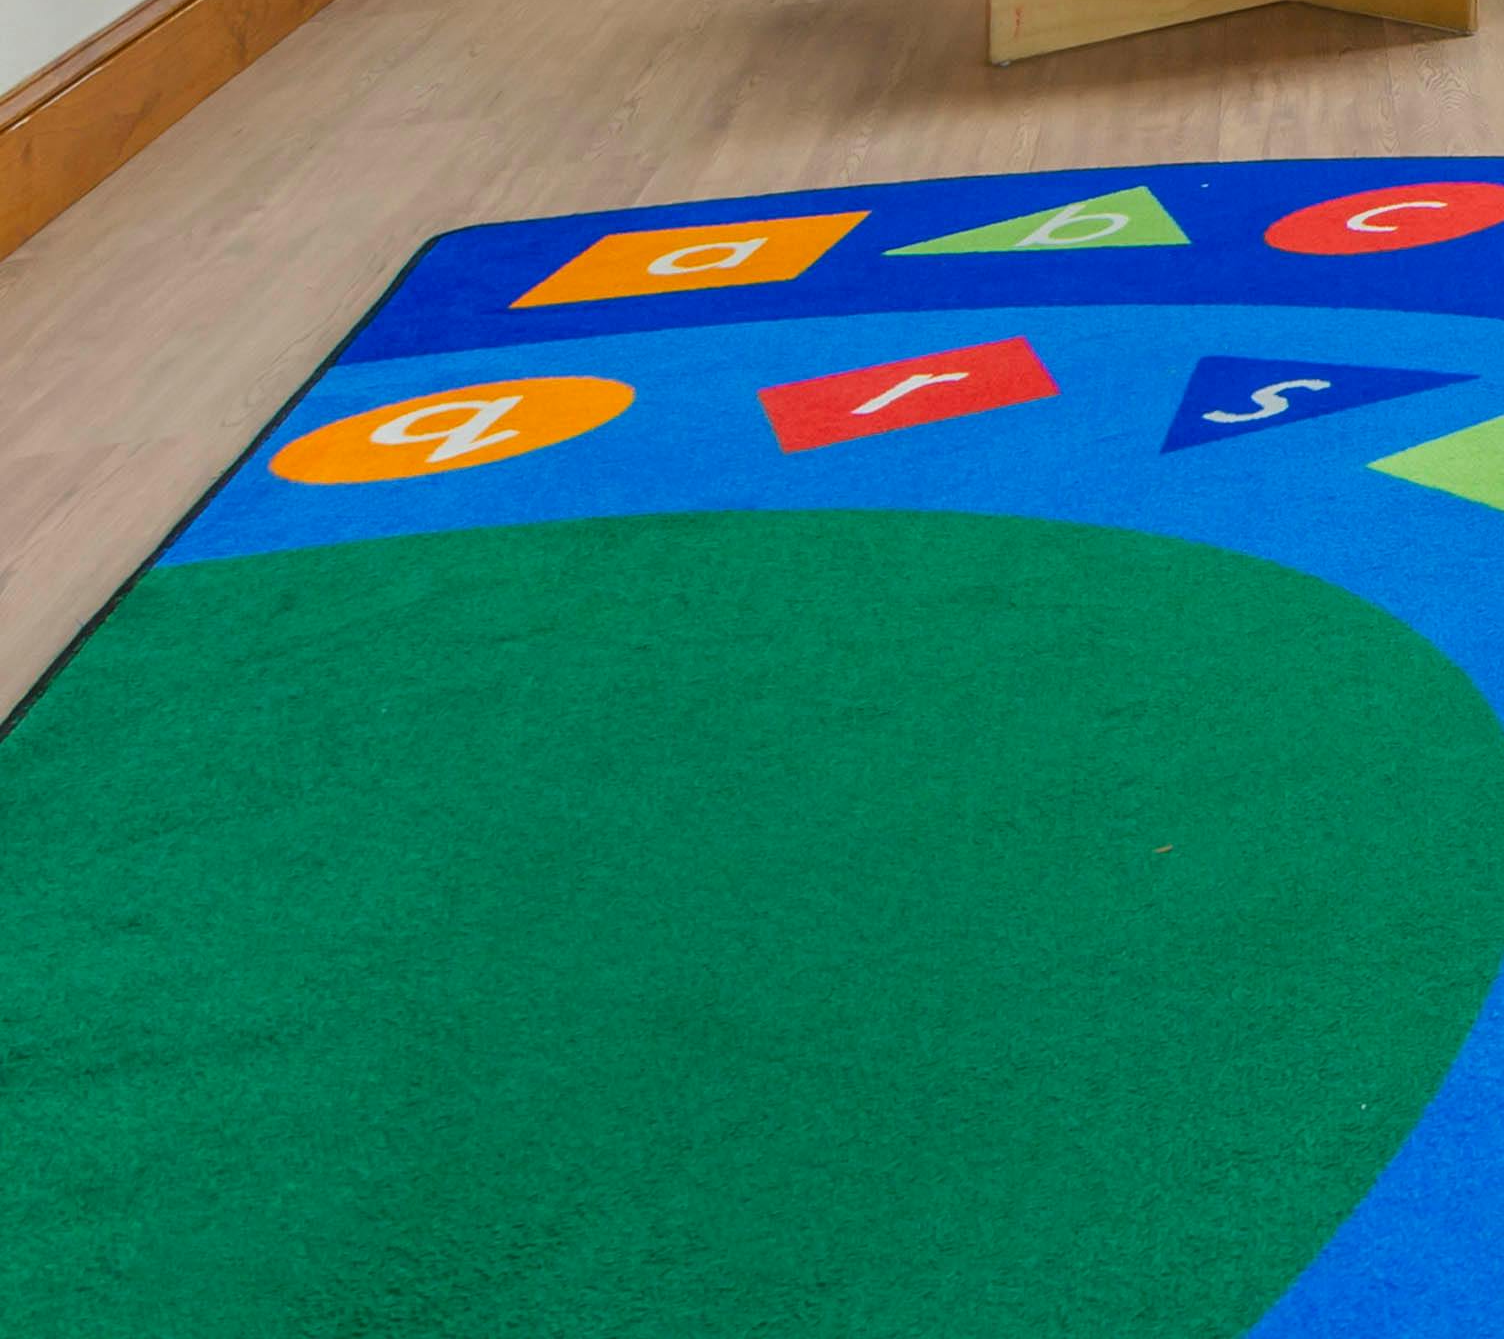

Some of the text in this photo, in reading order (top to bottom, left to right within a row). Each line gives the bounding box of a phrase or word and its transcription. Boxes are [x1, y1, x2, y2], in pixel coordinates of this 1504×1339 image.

[1012, 202, 1130, 248] b
[1346, 202, 1447, 232] c
[645, 230, 769, 278] a
[853, 371, 970, 416] r
[1203, 378, 1331, 424] s
[370, 390, 522, 464] q
